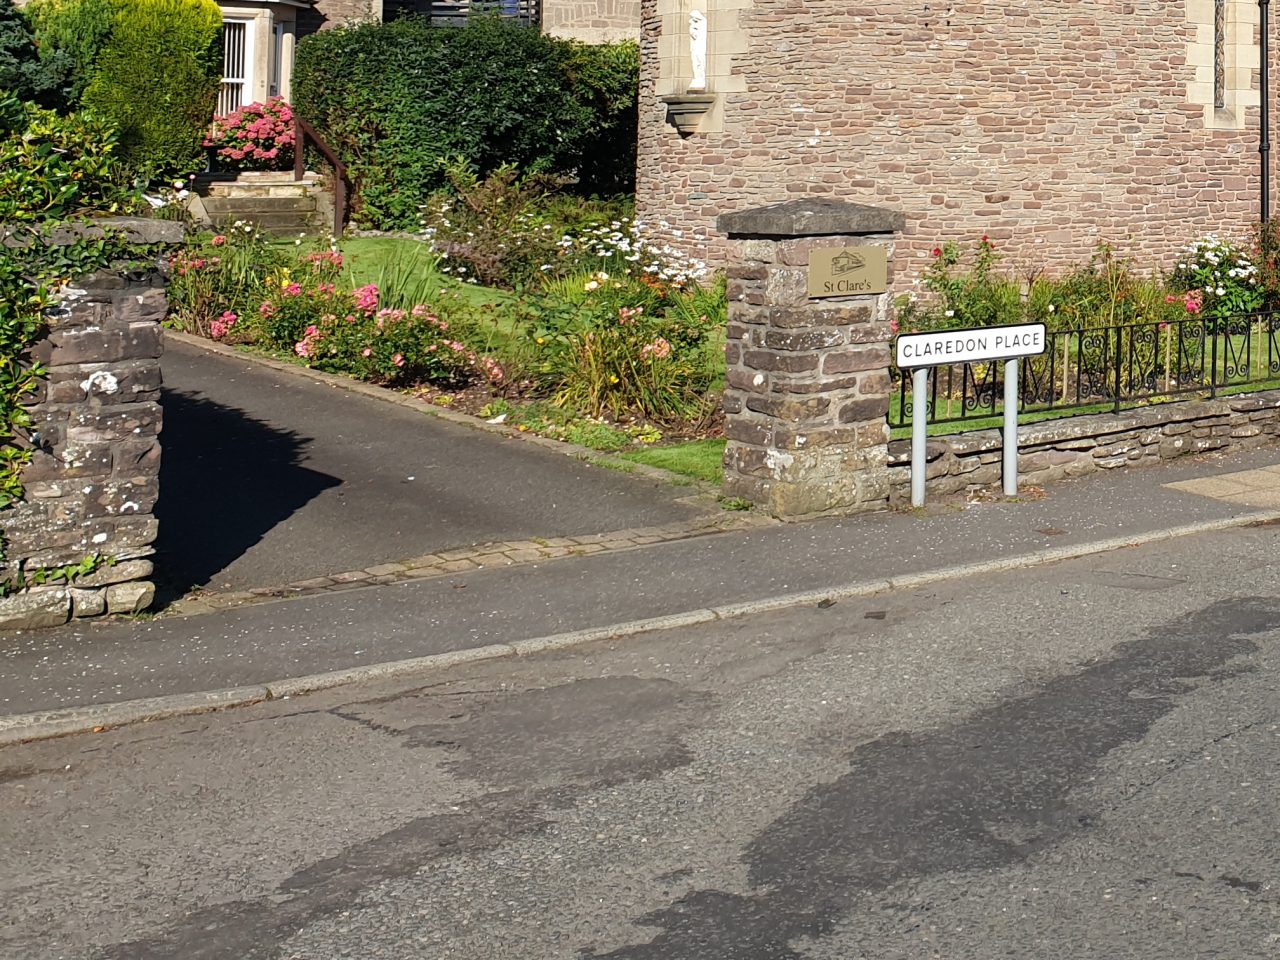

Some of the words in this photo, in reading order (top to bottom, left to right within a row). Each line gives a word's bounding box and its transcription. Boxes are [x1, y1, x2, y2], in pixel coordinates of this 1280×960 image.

[824, 281, 834, 293] St
[837, 278, 872, 292] Clare's
[903, 337, 987, 358] CLAREDON
[995, 332, 1040, 349] PLACE
